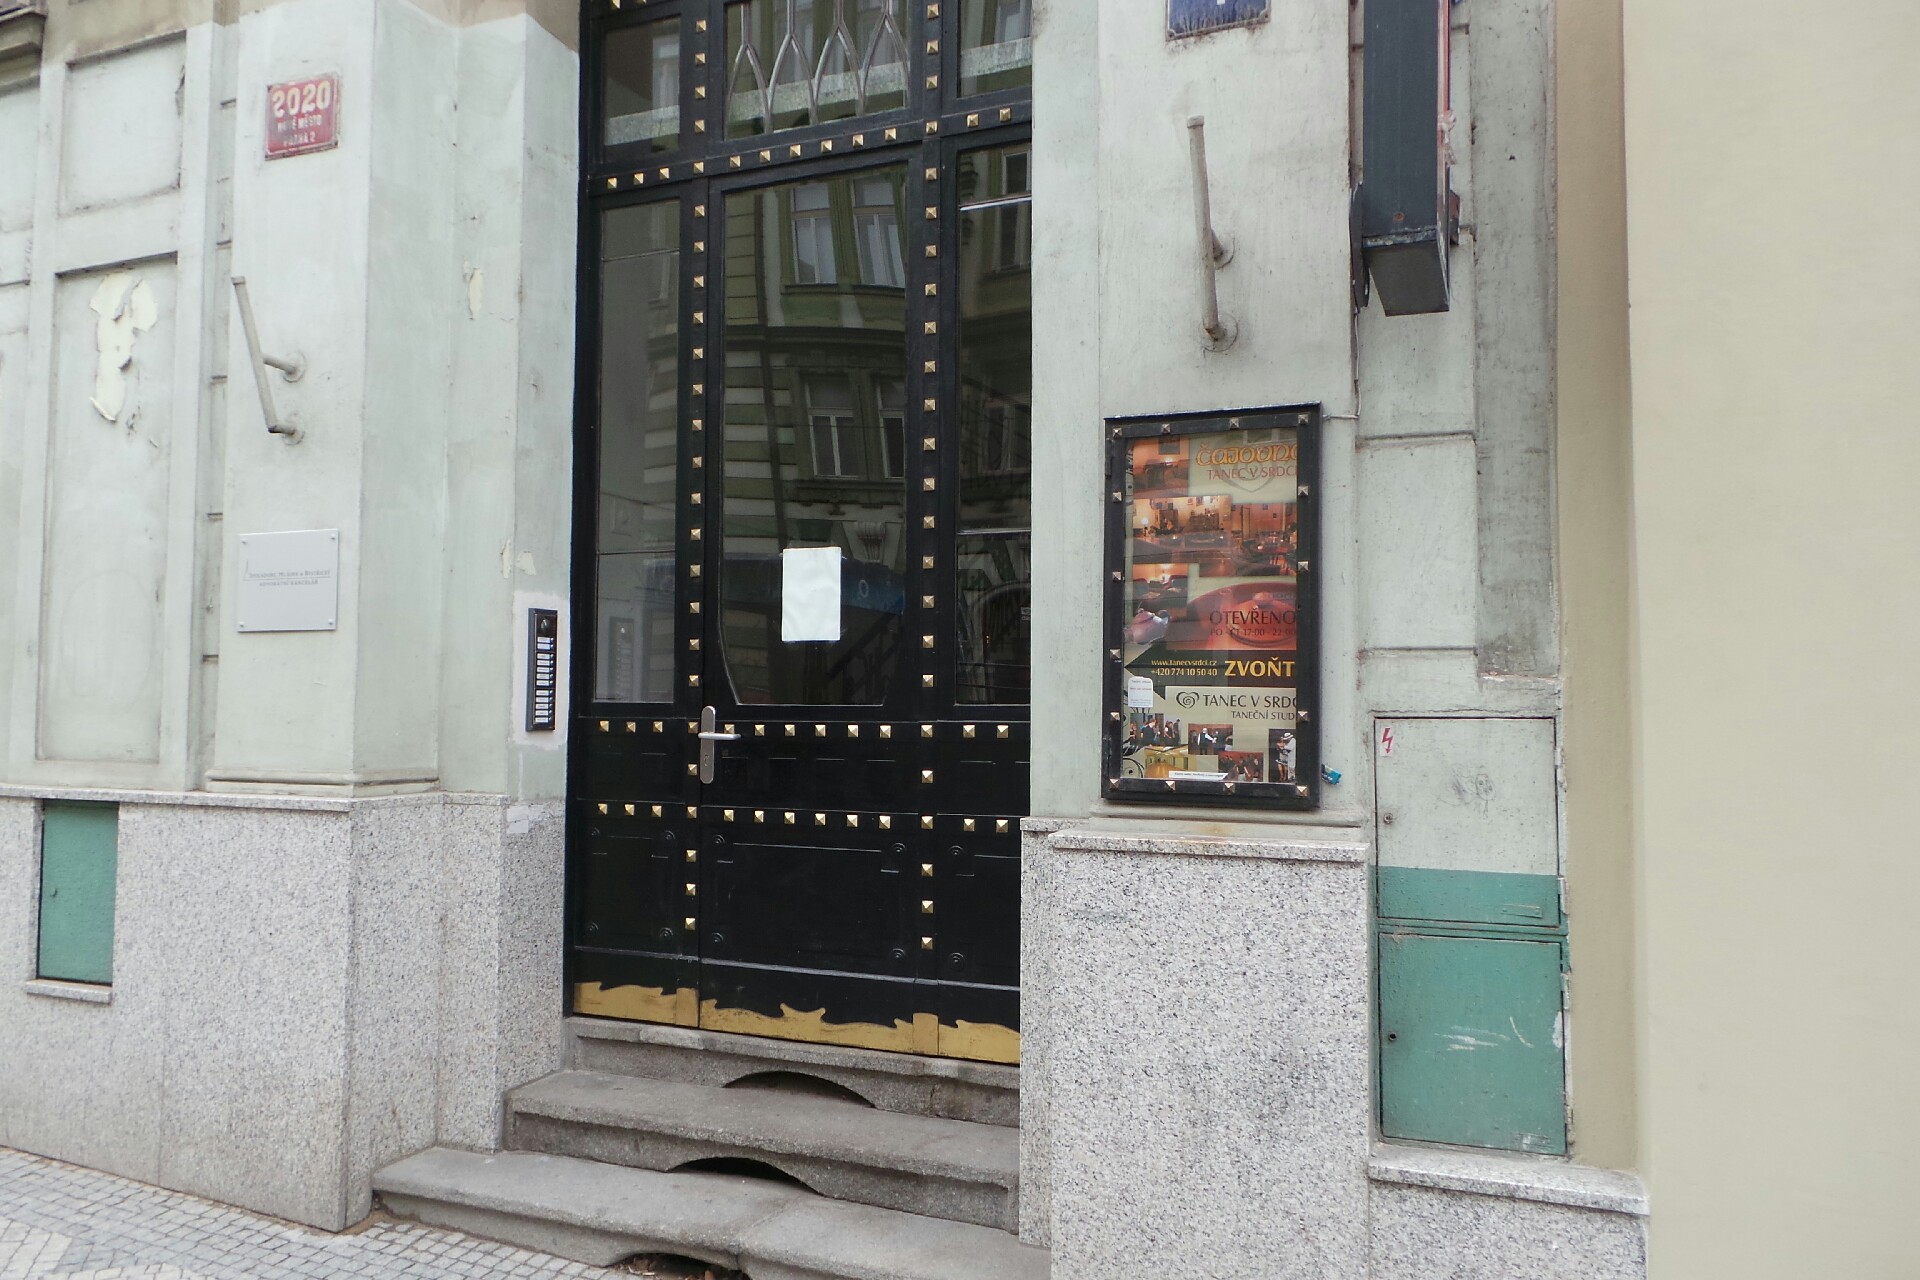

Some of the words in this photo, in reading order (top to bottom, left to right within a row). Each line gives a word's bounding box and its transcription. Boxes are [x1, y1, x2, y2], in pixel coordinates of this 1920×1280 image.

[272, 80, 331, 118] 2020
[309, 131, 316, 143] 2
[1207, 469, 1245, 481] TANEC
[1249, 469, 1258, 478] V
[1209, 608, 1296, 625] OTEVŘENO
[1150, 667, 1170, 676] +420
[1171, 667, 1184, 676] 774
[1186, 667, 1196, 676] 10
[1196, 668, 1206, 676] 50
[1207, 668, 1218, 676] 40
[1224, 656, 1296, 677] ZVOŇT
[1202, 694, 1247, 708] TANEC
[1250, 695, 1261, 708] V
[1231, 709, 1269, 720] TANEČNÍ
[1271, 711, 1295, 721] STUD
